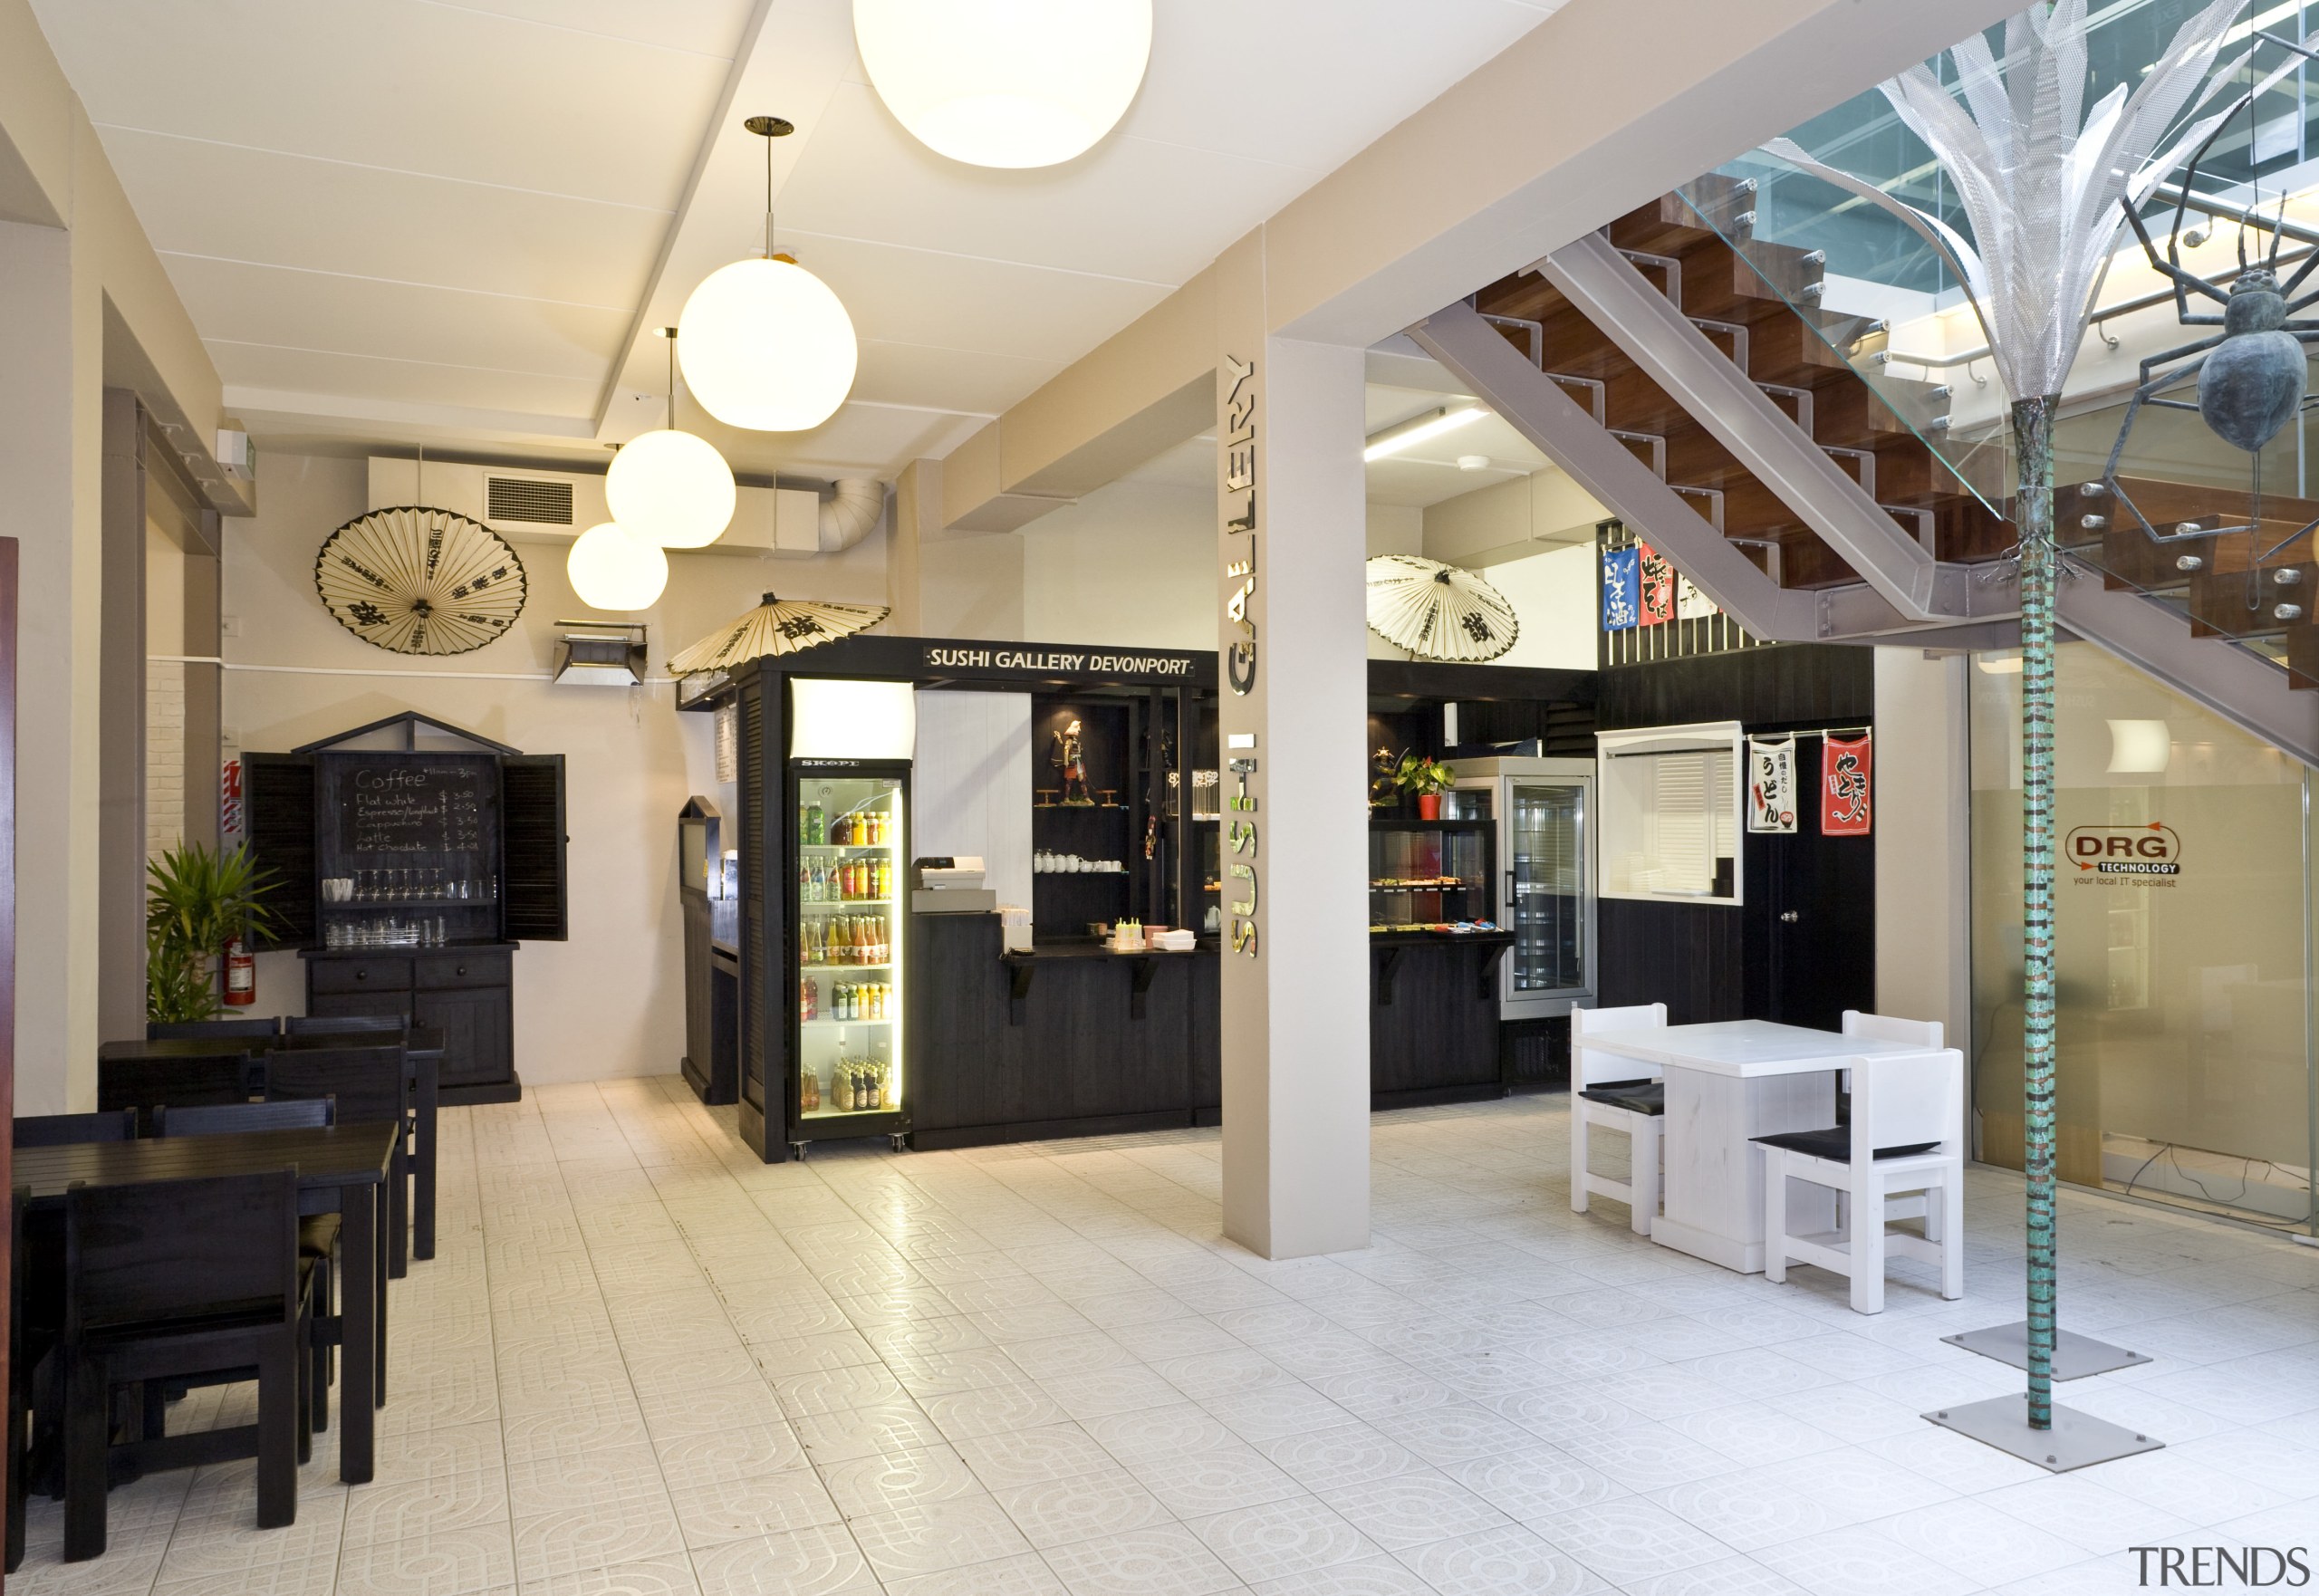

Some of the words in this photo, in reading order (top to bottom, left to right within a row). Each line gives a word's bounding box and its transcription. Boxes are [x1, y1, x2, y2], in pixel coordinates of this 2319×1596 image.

[1227, 354, 1256, 697] GALLERY
[930, 649, 990, 668] SUSHI
[995, 651, 1084, 670] GALLERY
[1089, 655, 1190, 675] DEVONPORT
[356, 769, 428, 792] Coffee
[1763, 756, 1779, 823] うどん
[1833, 753, 1866, 822] やきとり
[1228, 734, 1257, 959] SUSHI
[2076, 836, 2167, 858] DRG
[2101, 863, 2177, 873] TECHNOLOGY
[2074, 877, 2094, 886] your
[2096, 877, 2117, 886] local
[2120, 877, 2130, 885] IT
[2131, 877, 2177, 888] specialist
